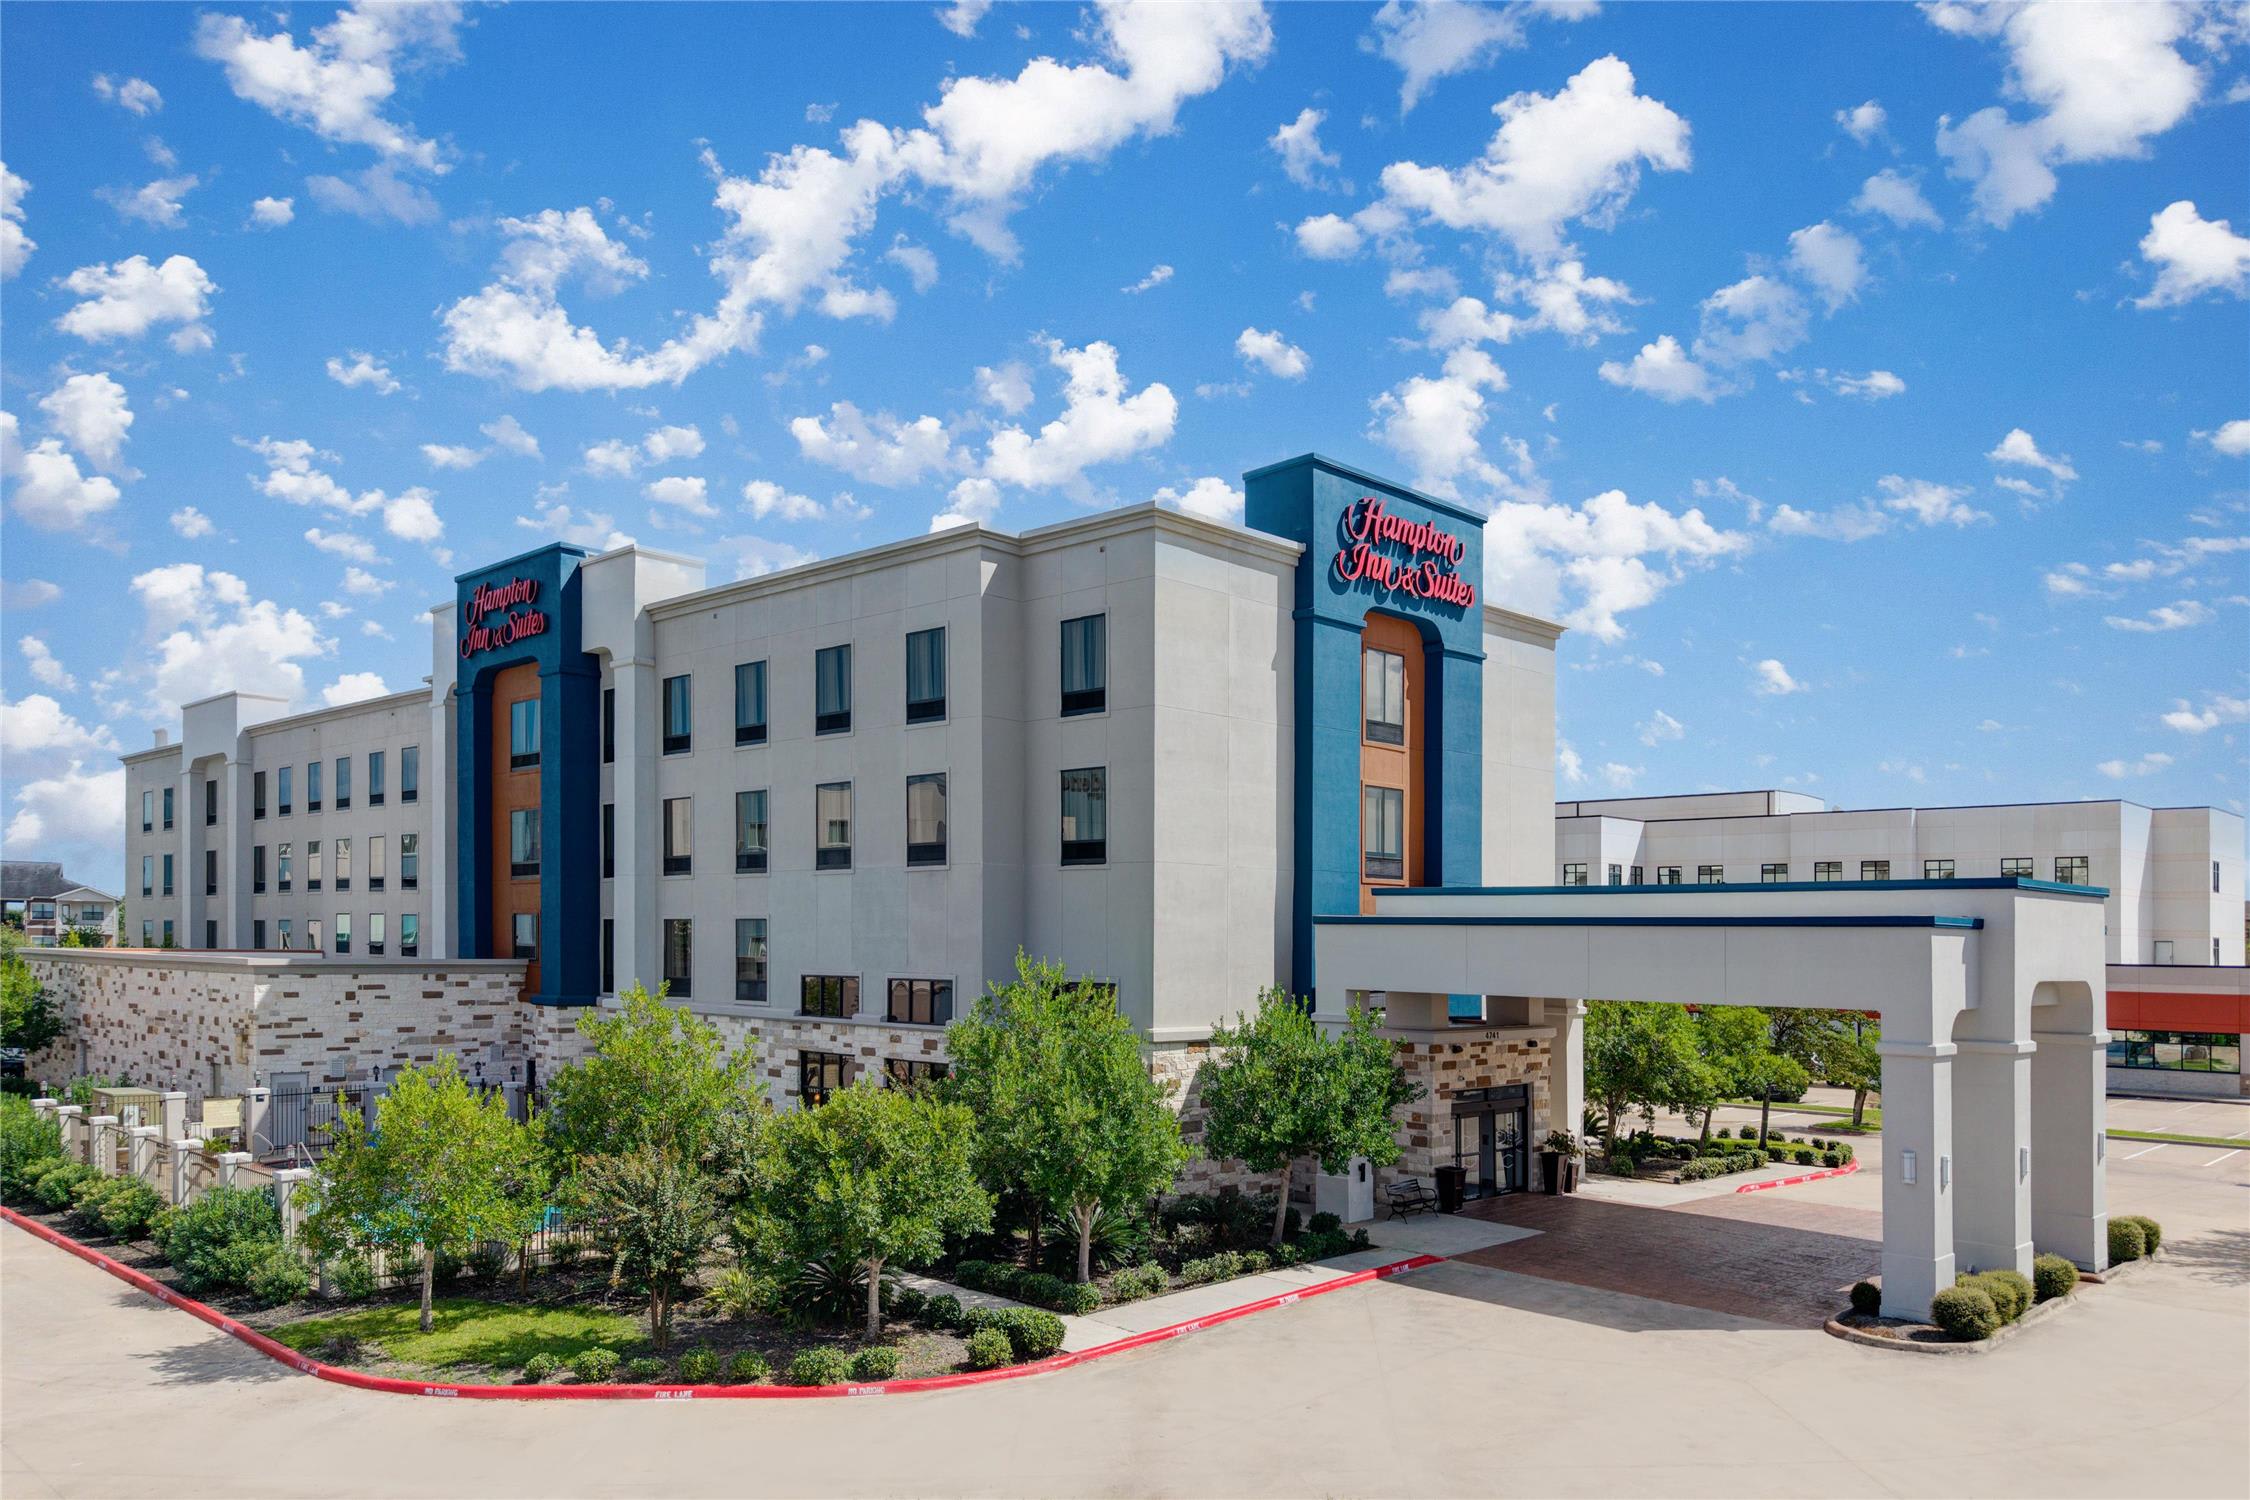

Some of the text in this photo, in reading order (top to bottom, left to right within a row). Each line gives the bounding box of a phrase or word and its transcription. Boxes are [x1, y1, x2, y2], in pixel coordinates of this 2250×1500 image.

[1346, 496, 1466, 566] Hampton
[465, 577, 538, 626] Hampton
[1338, 543, 1476, 609] Inn & Suites
[460, 608, 545, 659] Inn & Suites
[654, 1390, 693, 1399] FIRE LANE
